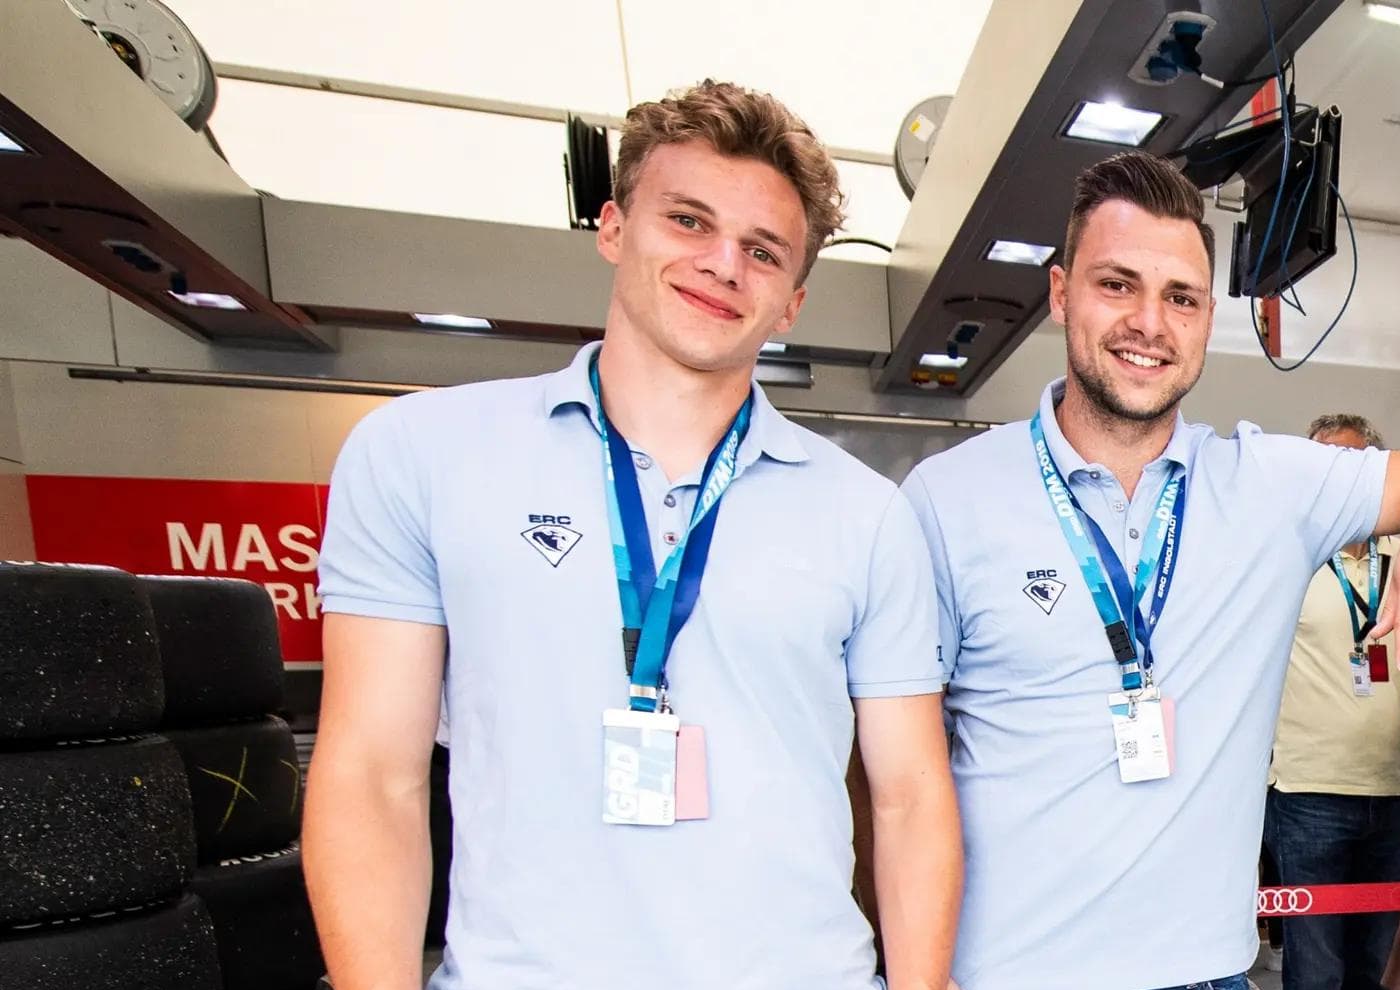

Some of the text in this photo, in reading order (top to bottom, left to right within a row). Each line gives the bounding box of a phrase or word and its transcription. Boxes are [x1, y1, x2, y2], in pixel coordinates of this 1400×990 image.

[527, 513, 572, 526] ERC
[165, 522, 318, 572] MAS
[1026, 569, 1057, 579] ERC
